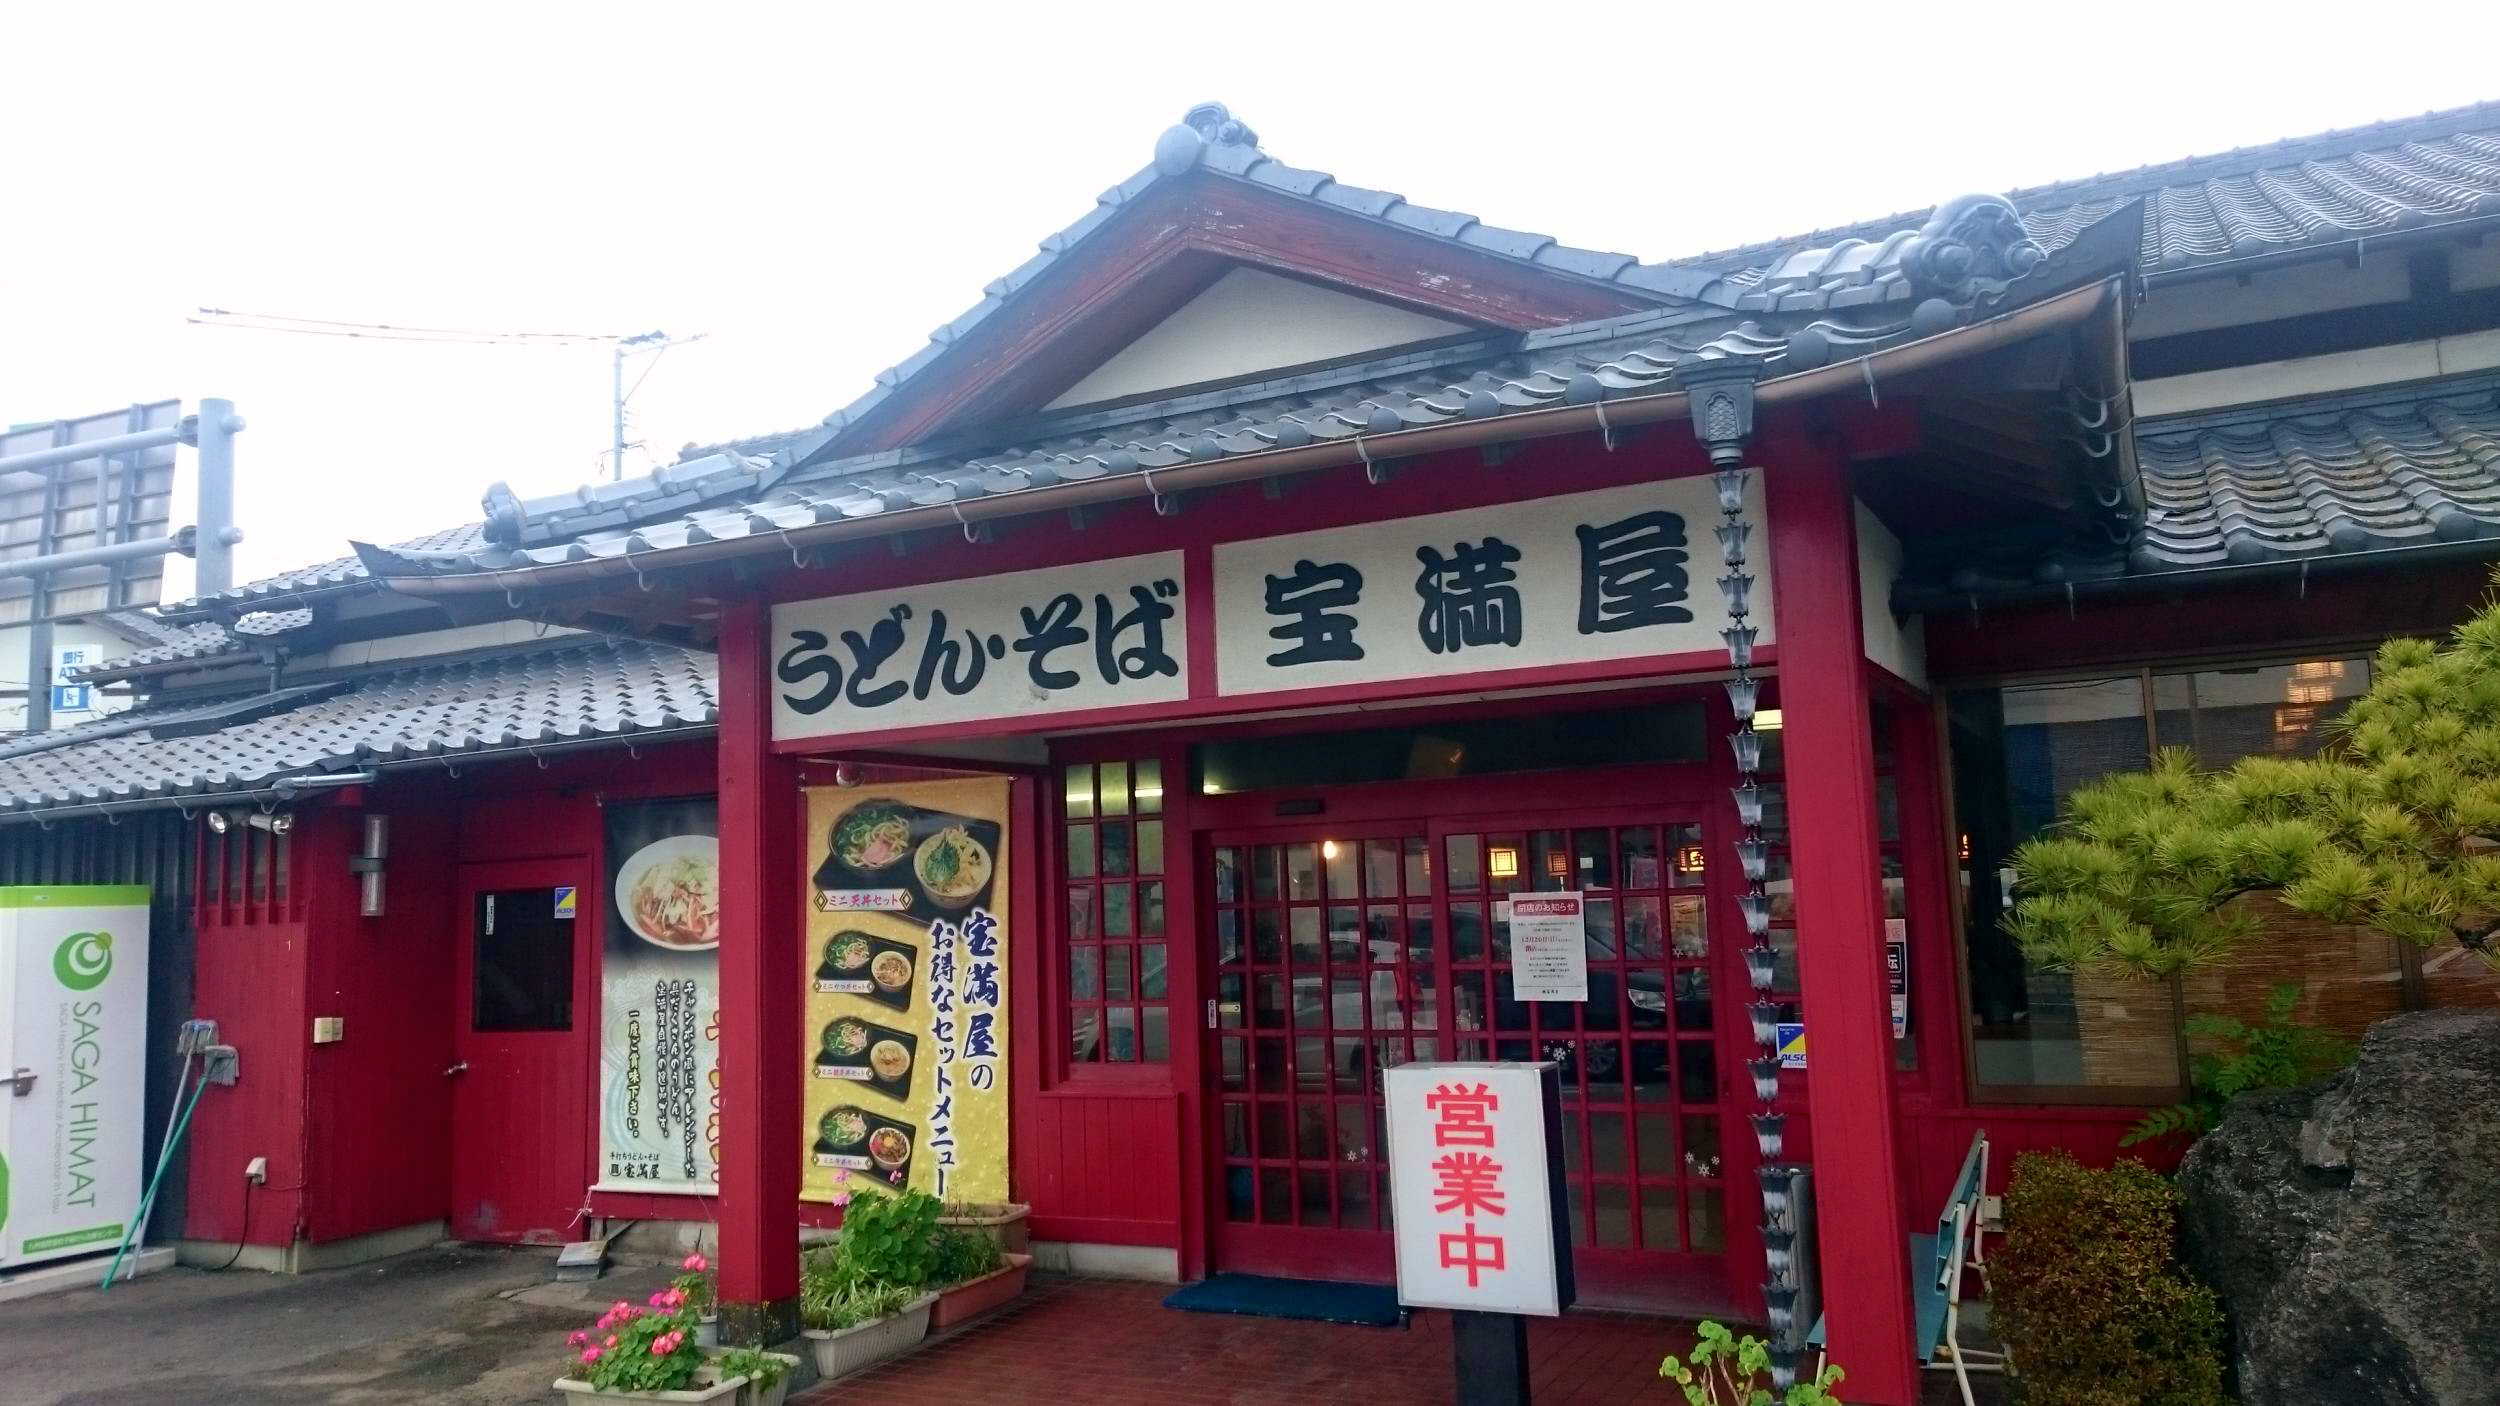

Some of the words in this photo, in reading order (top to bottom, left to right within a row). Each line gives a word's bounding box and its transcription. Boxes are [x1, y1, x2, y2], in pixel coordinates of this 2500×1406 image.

[777, 579, 1181, 715] うどん・そば
[1265, 511, 1695, 667] 宝満屋
[71, 1001, 102, 1095] SAGA
[930, 921, 958, 1196] お得なセットメニュー
[962, 910, 1000, 1090] 宝満屋の
[67, 1102, 98, 1208] HIMAT
[1425, 1082, 1507, 1288] 営業中
